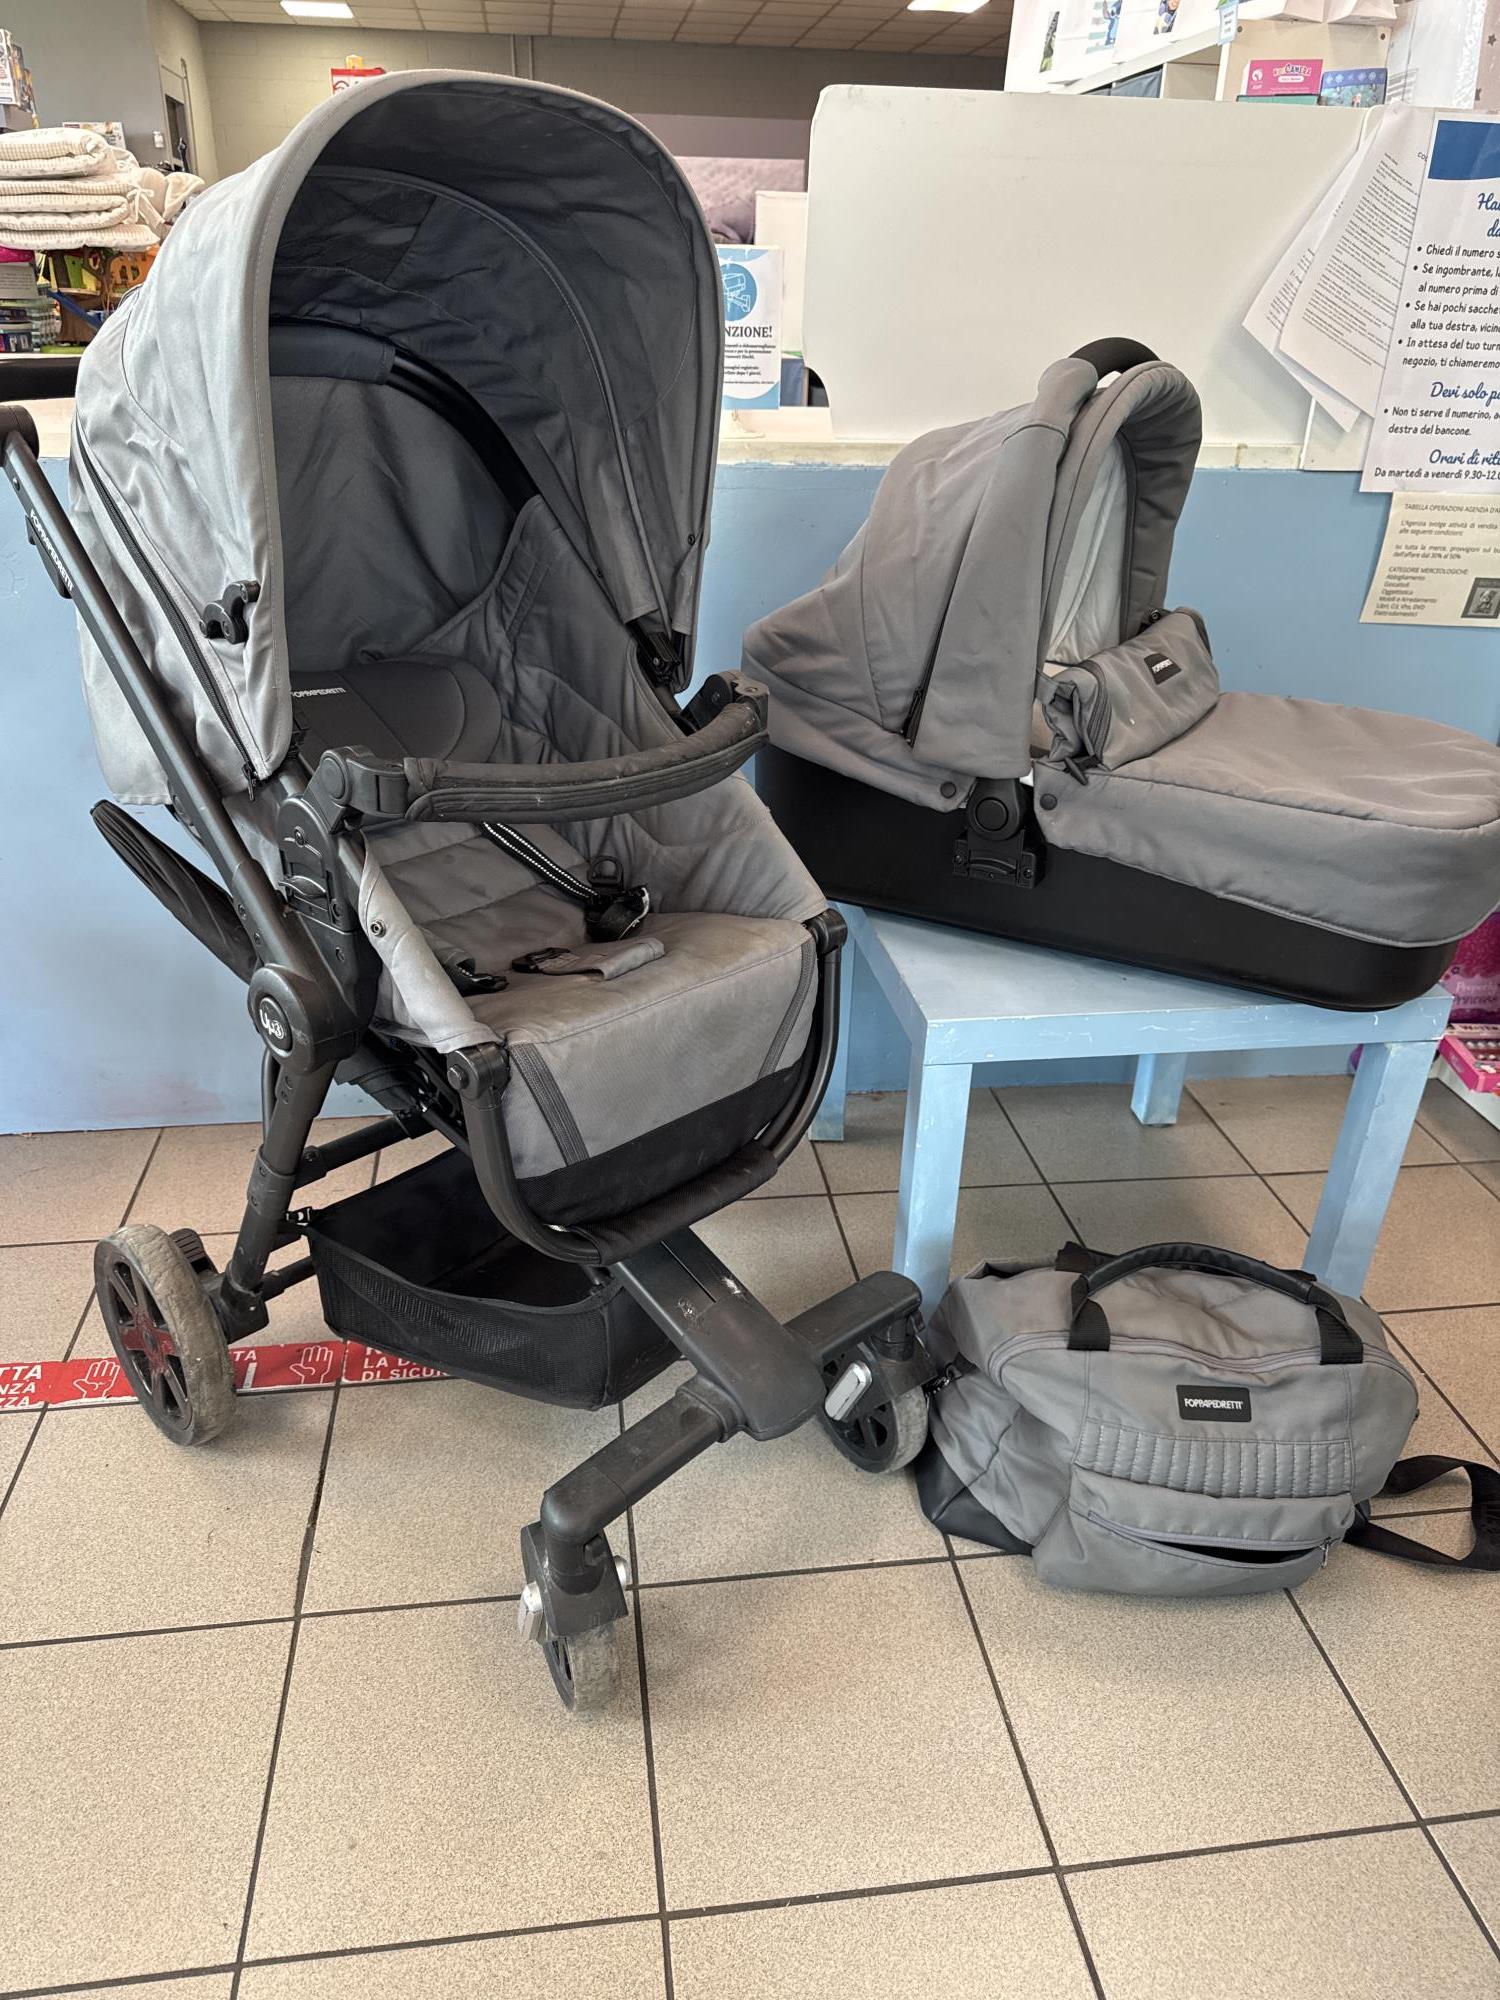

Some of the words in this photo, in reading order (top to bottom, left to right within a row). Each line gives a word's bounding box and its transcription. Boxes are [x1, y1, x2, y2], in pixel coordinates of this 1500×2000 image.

[1426, 244, 1454, 256] Chiedi
[1455, 245, 1461, 256] il
[1462, 249, 1495, 258] numero
[1422, 263, 1434, 274] Se
[1435, 264, 1493, 278] ingombrante,
[1418, 282, 1427, 292] al
[1428, 285, 1460, 295] numero
[1461, 285, 1488, 297] prima
[1490, 284, 1499, 296] di
[1414, 301, 1425, 311] Se
[1428, 301, 1441, 311] hai
[1442, 301, 1467, 314] pochi
[1468, 303, 1500, 315] sacche
[1410, 319, 1426, 330] alla
[1428, 320, 1443, 331] tua
[1445, 320, 1477, 333] destra,
[1406, 337, 1416, 348] In
[1418, 339, 1448, 349] attesa
[1450, 339, 1464, 349] del
[1466, 341, 1480, 350] tuo
[1402, 356, 1438, 369] negozio,
[1440, 358, 1447, 367] ti
[1448, 357, 1500, 369] chiameremo
[1430, 381, 1460, 398] Devi
[1462, 382, 1488, 399] solo
[1392, 407, 1408, 417] Non
[1411, 407, 1418, 417] ti
[1419, 408, 1443, 418] serve
[1445, 408, 1451, 418] il
[1451, 410, 1491, 421] numerino,
[1388, 423, 1418, 434] destra
[1420, 424, 1434, 434] del
[1429, 449, 1466, 465] Orari
[1467, 448, 1480, 465] di
[1374, 467, 1386, 477] Da
[228, 1349, 257, 1362] TA
[363, 1356, 389, 1369] LA
[362, 1370, 382, 1381] DI
[1183, 1397, 1244, 1410] FOPPAPEDRETTI
